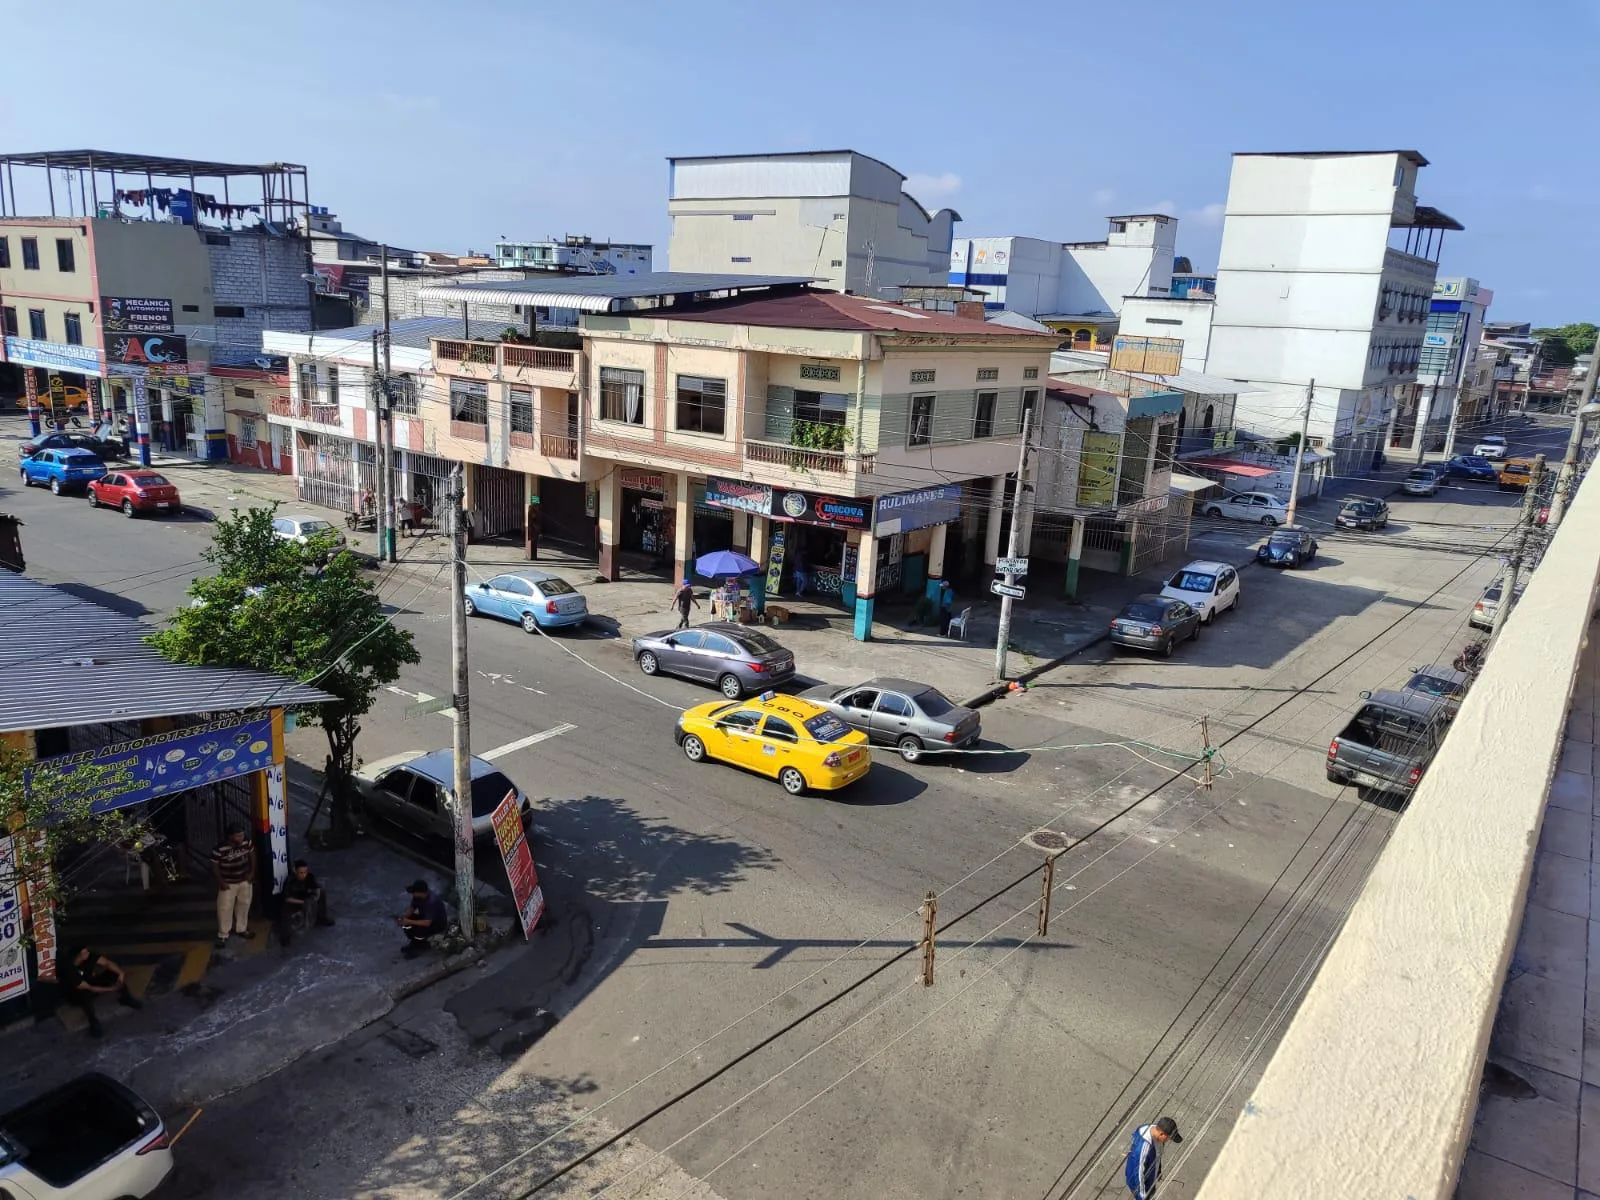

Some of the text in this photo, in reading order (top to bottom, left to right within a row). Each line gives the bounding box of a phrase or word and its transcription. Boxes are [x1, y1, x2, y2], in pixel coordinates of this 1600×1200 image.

[879, 488, 945, 511] RULIMANES
[30, 749, 96, 774] TALLER
[97, 723, 208, 759] AUTOMOTRIZ
